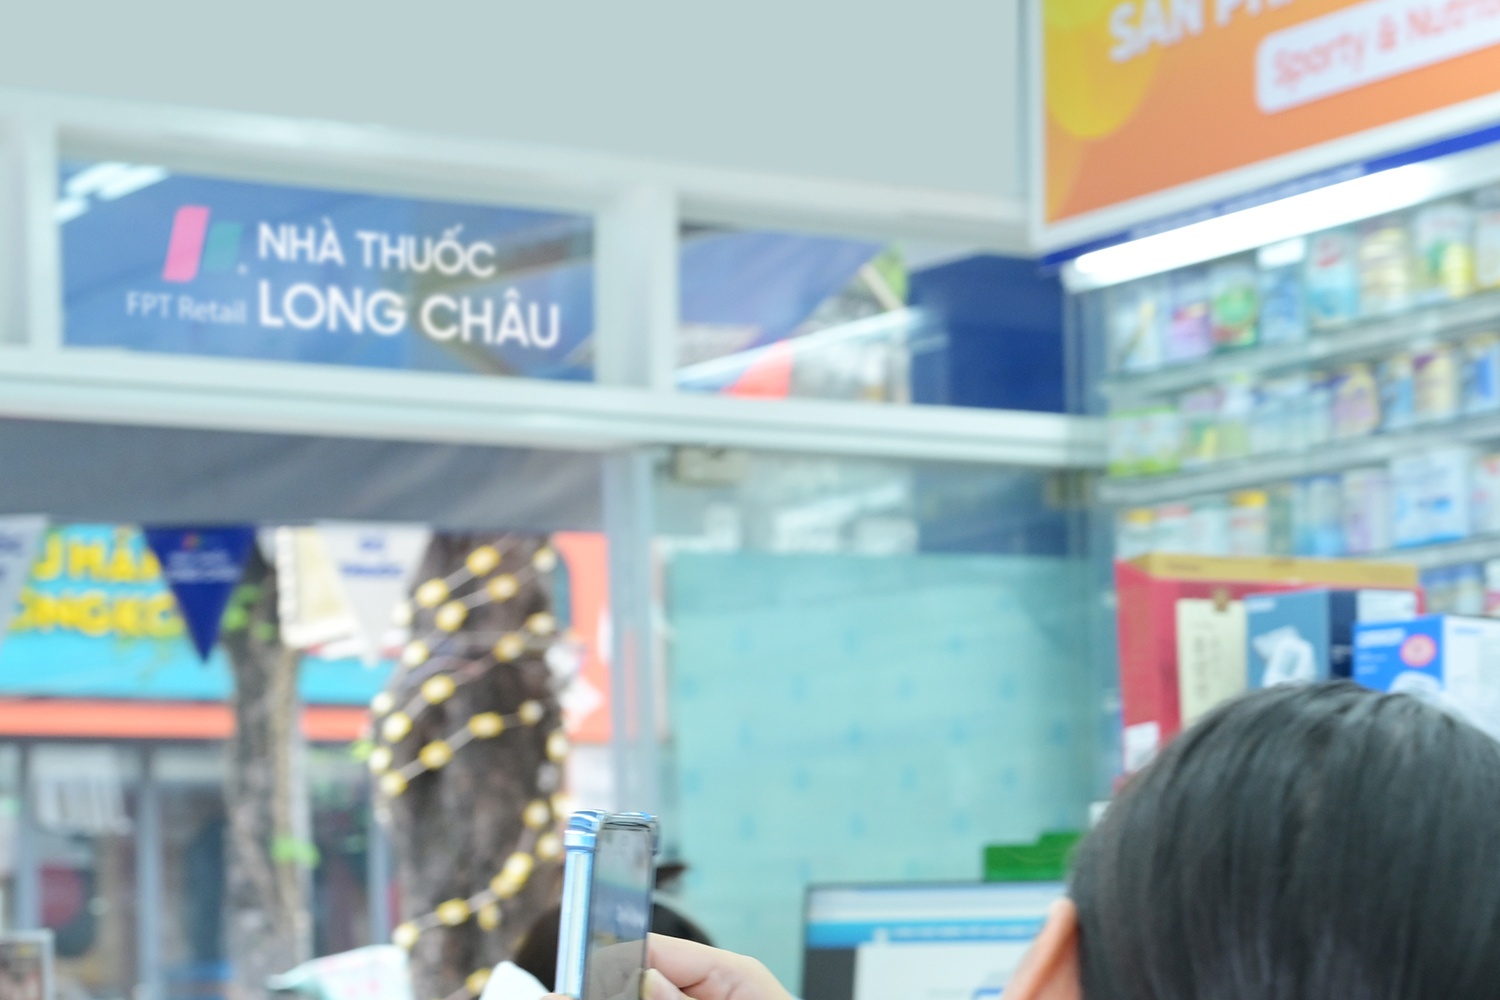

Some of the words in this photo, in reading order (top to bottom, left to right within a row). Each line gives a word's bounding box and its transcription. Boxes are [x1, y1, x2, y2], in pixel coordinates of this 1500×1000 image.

[258, 217, 345, 266] NHÀ
[356, 224, 496, 277] THUỐC
[126, 290, 172, 318] FPT
[177, 294, 247, 324] Retail
[259, 279, 407, 335] LONG
[420, 288, 560, 348] CHÂU
